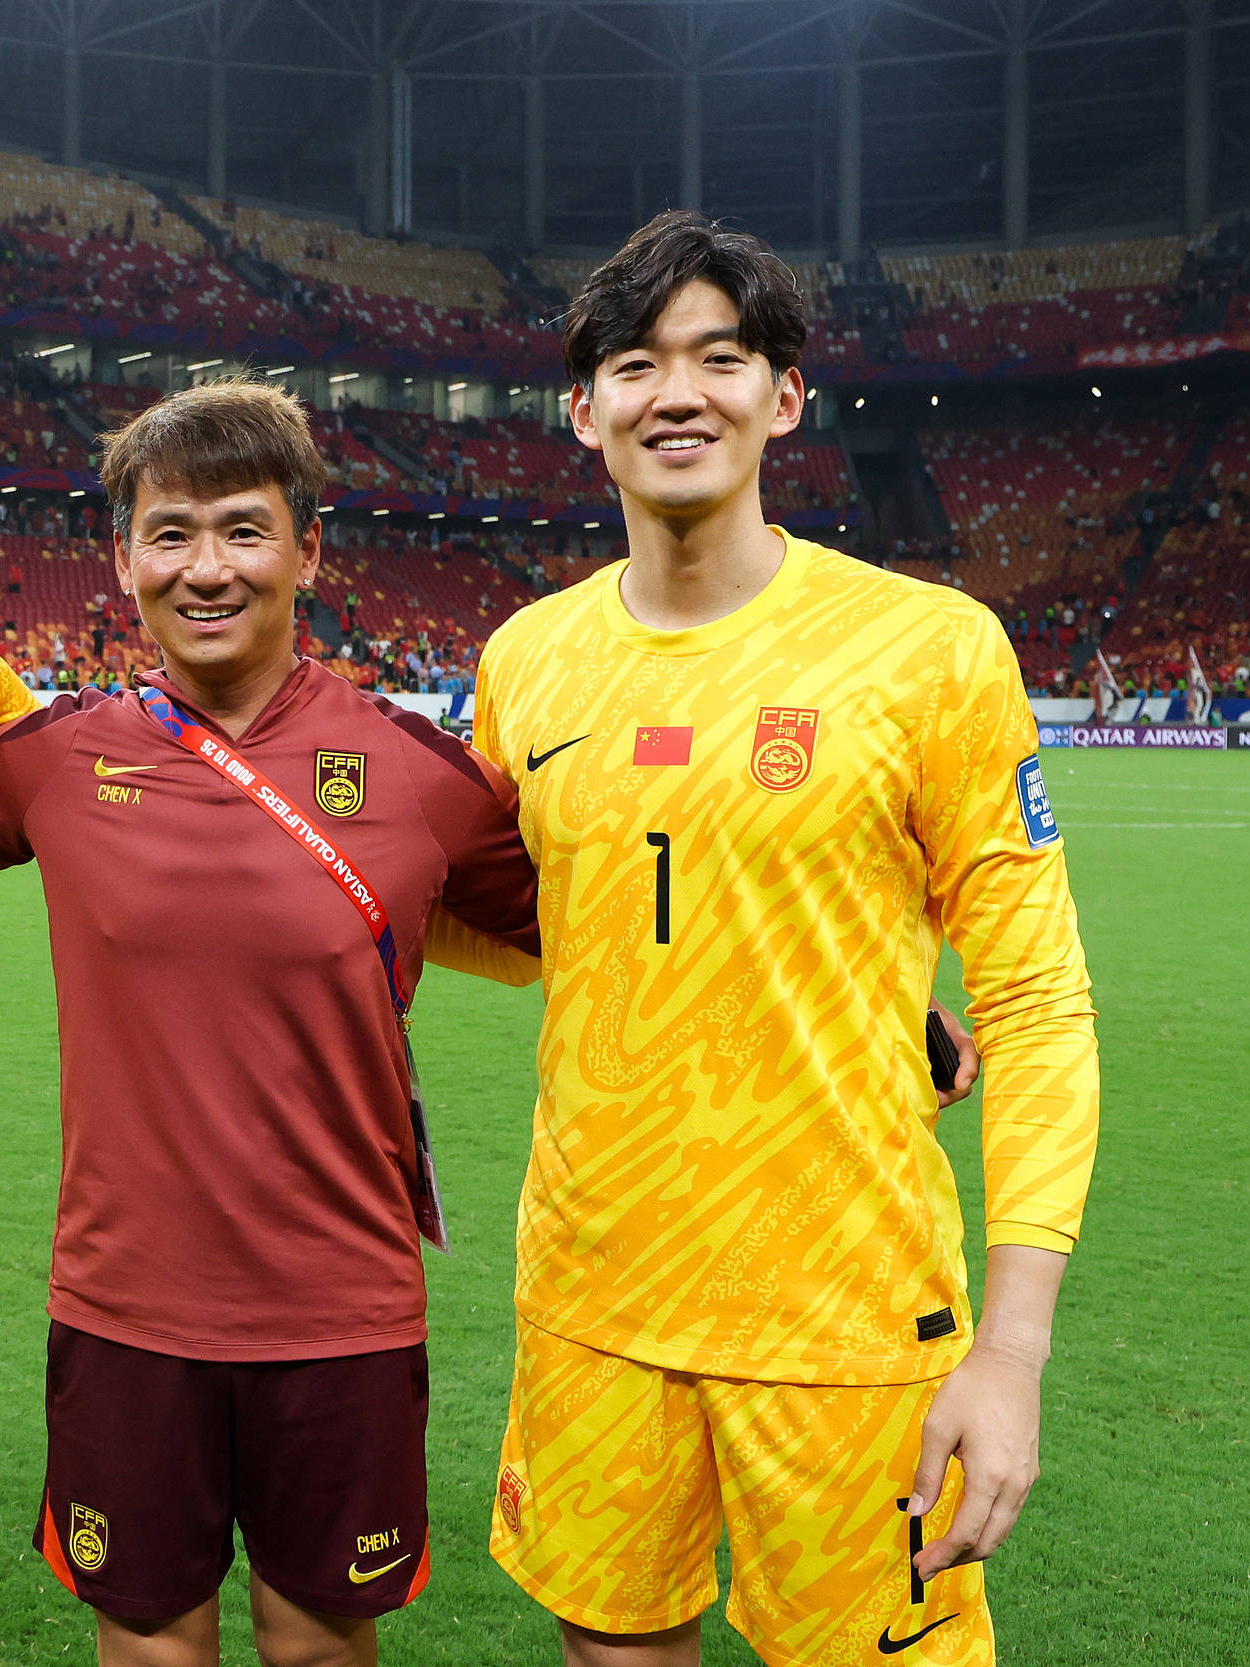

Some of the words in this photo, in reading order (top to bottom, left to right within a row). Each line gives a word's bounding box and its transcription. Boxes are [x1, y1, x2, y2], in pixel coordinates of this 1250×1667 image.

[759, 709, 816, 728] CFA
[774, 725, 797, 738] 中国
[1073, 727, 1136, 748] QATAR
[1141, 727, 1225, 748] AIRWAYS
[200, 739, 219, 756] 26
[213, 749, 230, 767] TO
[225, 759, 256, 786] ROAD
[321, 755, 360, 771] CFA
[97, 784, 131, 804] CHEN
[131, 788, 143, 806] X
[255, 785, 337, 862] QUALIFIERS
[332, 858, 374, 905] ASIAN
[646, 831, 670, 945] 1
[502, 1466, 525, 1497] CFA
[74, 1506, 106, 1528] CFA
[356, 1531, 390, 1554] CHEN
[391, 1526, 401, 1546] X
[896, 1497, 925, 1605] 1
